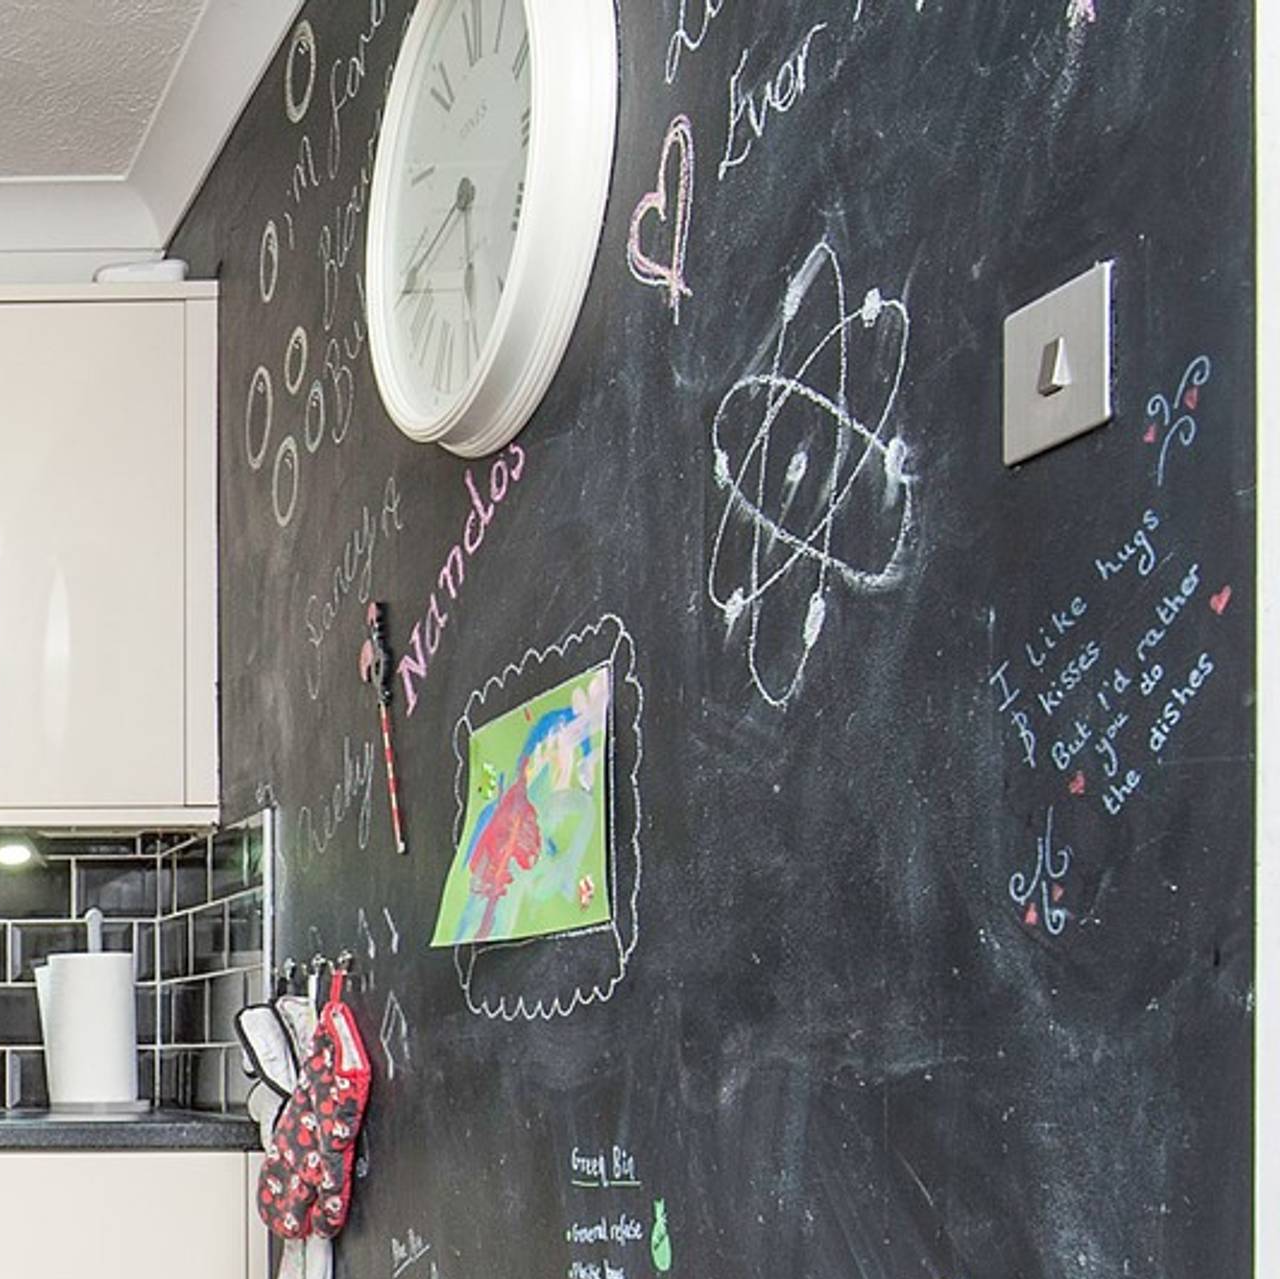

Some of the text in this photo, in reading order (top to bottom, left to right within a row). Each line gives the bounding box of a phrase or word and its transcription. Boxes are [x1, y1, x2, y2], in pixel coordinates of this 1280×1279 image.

[396, 442, 527, 717] Nandos
[1094, 508, 1161, 581] hugs
[1136, 563, 1201, 662] rather
[1094, 663, 1164, 778] you do
[1101, 651, 1216, 816] the dishes
